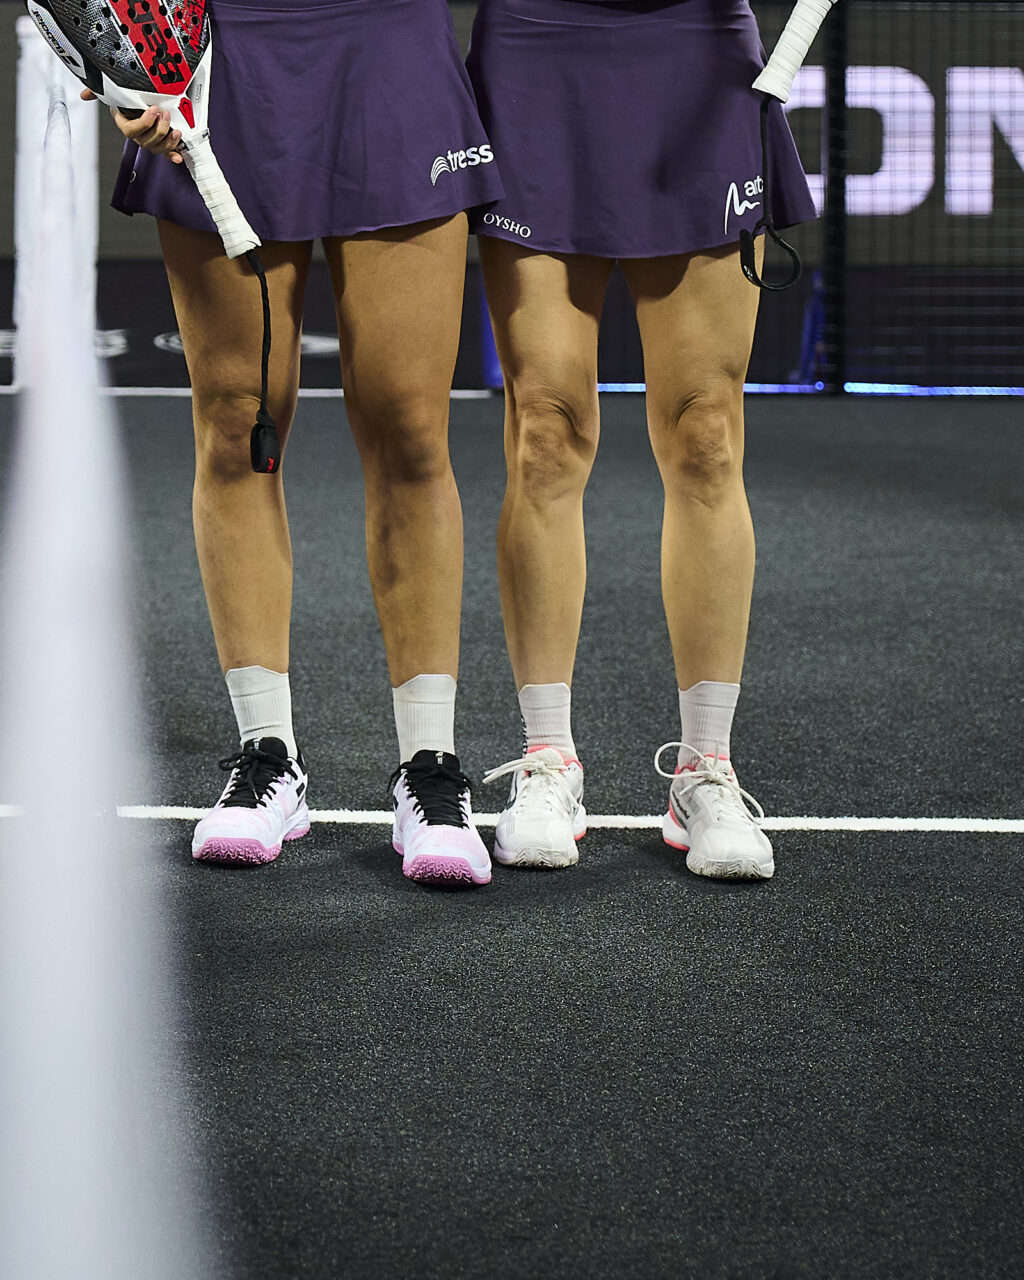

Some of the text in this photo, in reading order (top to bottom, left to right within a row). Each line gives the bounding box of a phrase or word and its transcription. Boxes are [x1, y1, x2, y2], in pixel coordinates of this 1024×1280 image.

[32, 10, 68, 55] Babolat
[447, 144, 494, 172] tress
[483, 213, 531, 238] OYSHO
